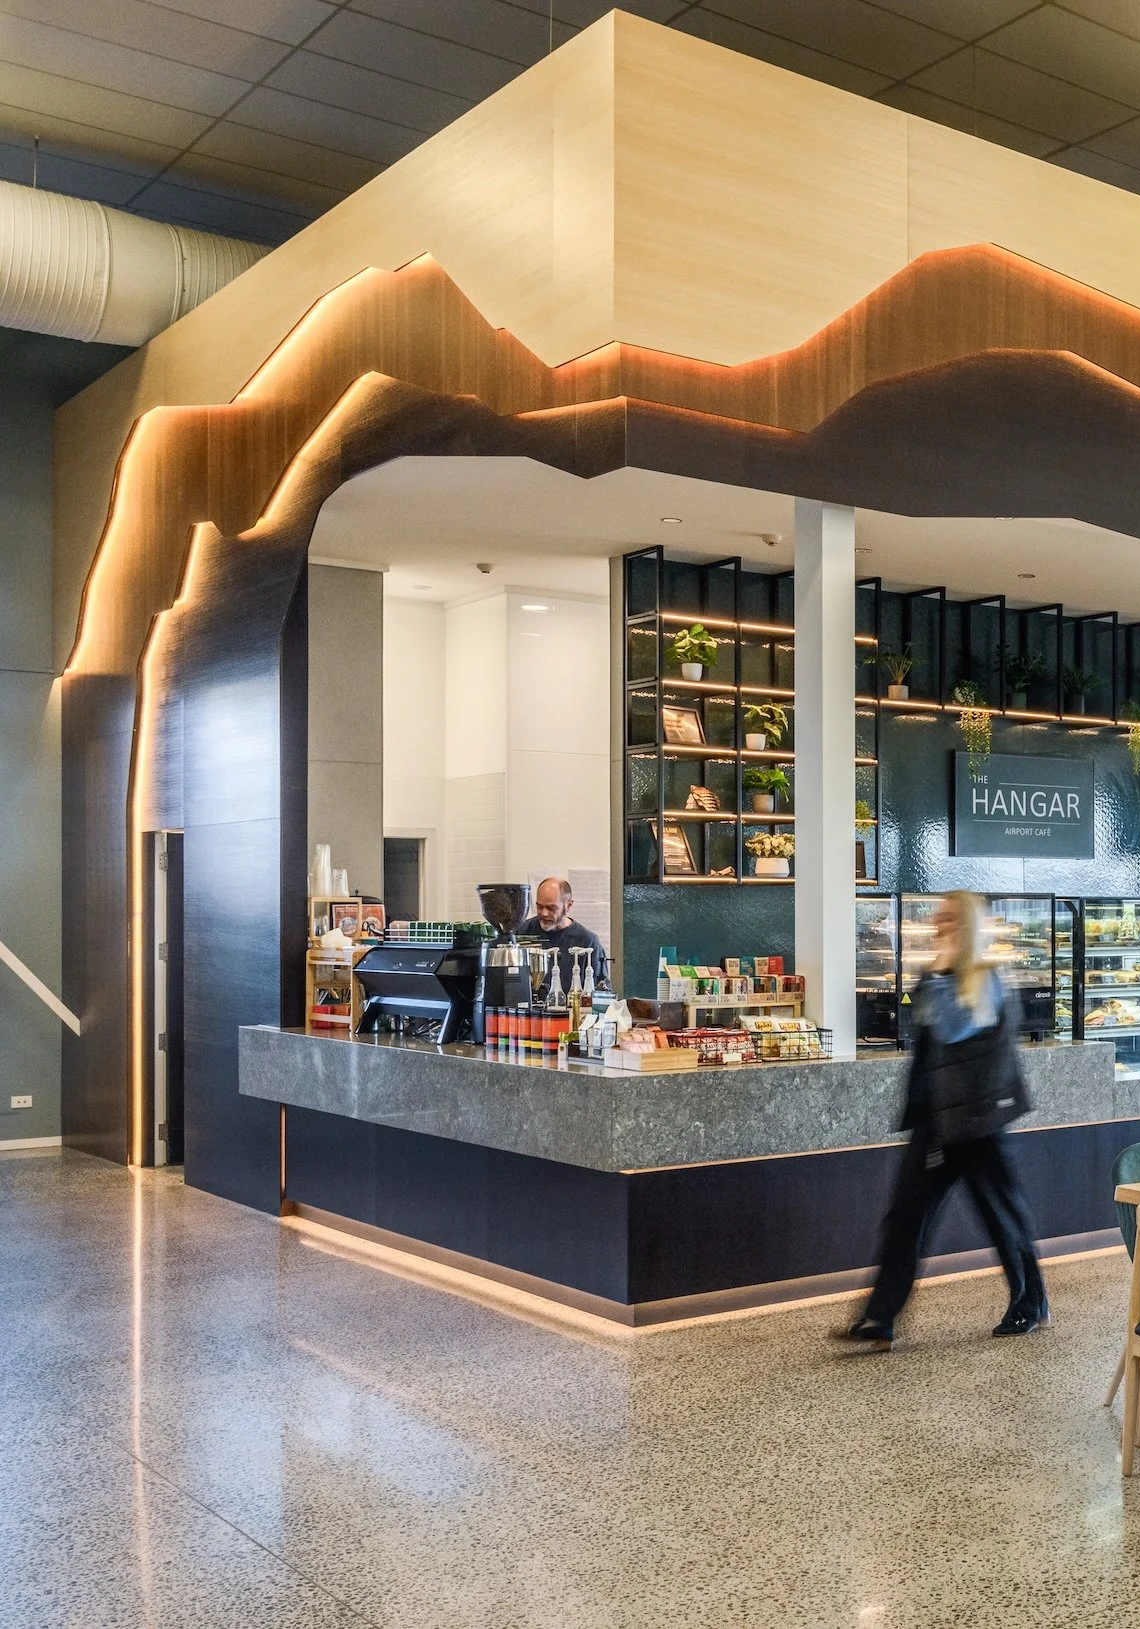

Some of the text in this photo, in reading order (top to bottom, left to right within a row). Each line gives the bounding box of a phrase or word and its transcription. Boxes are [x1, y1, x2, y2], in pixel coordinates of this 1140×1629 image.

[972, 774, 988, 784] THE
[972, 788, 1081, 819] HANGAR
[1004, 826, 1051, 837] AIRPORT CAFÉ
